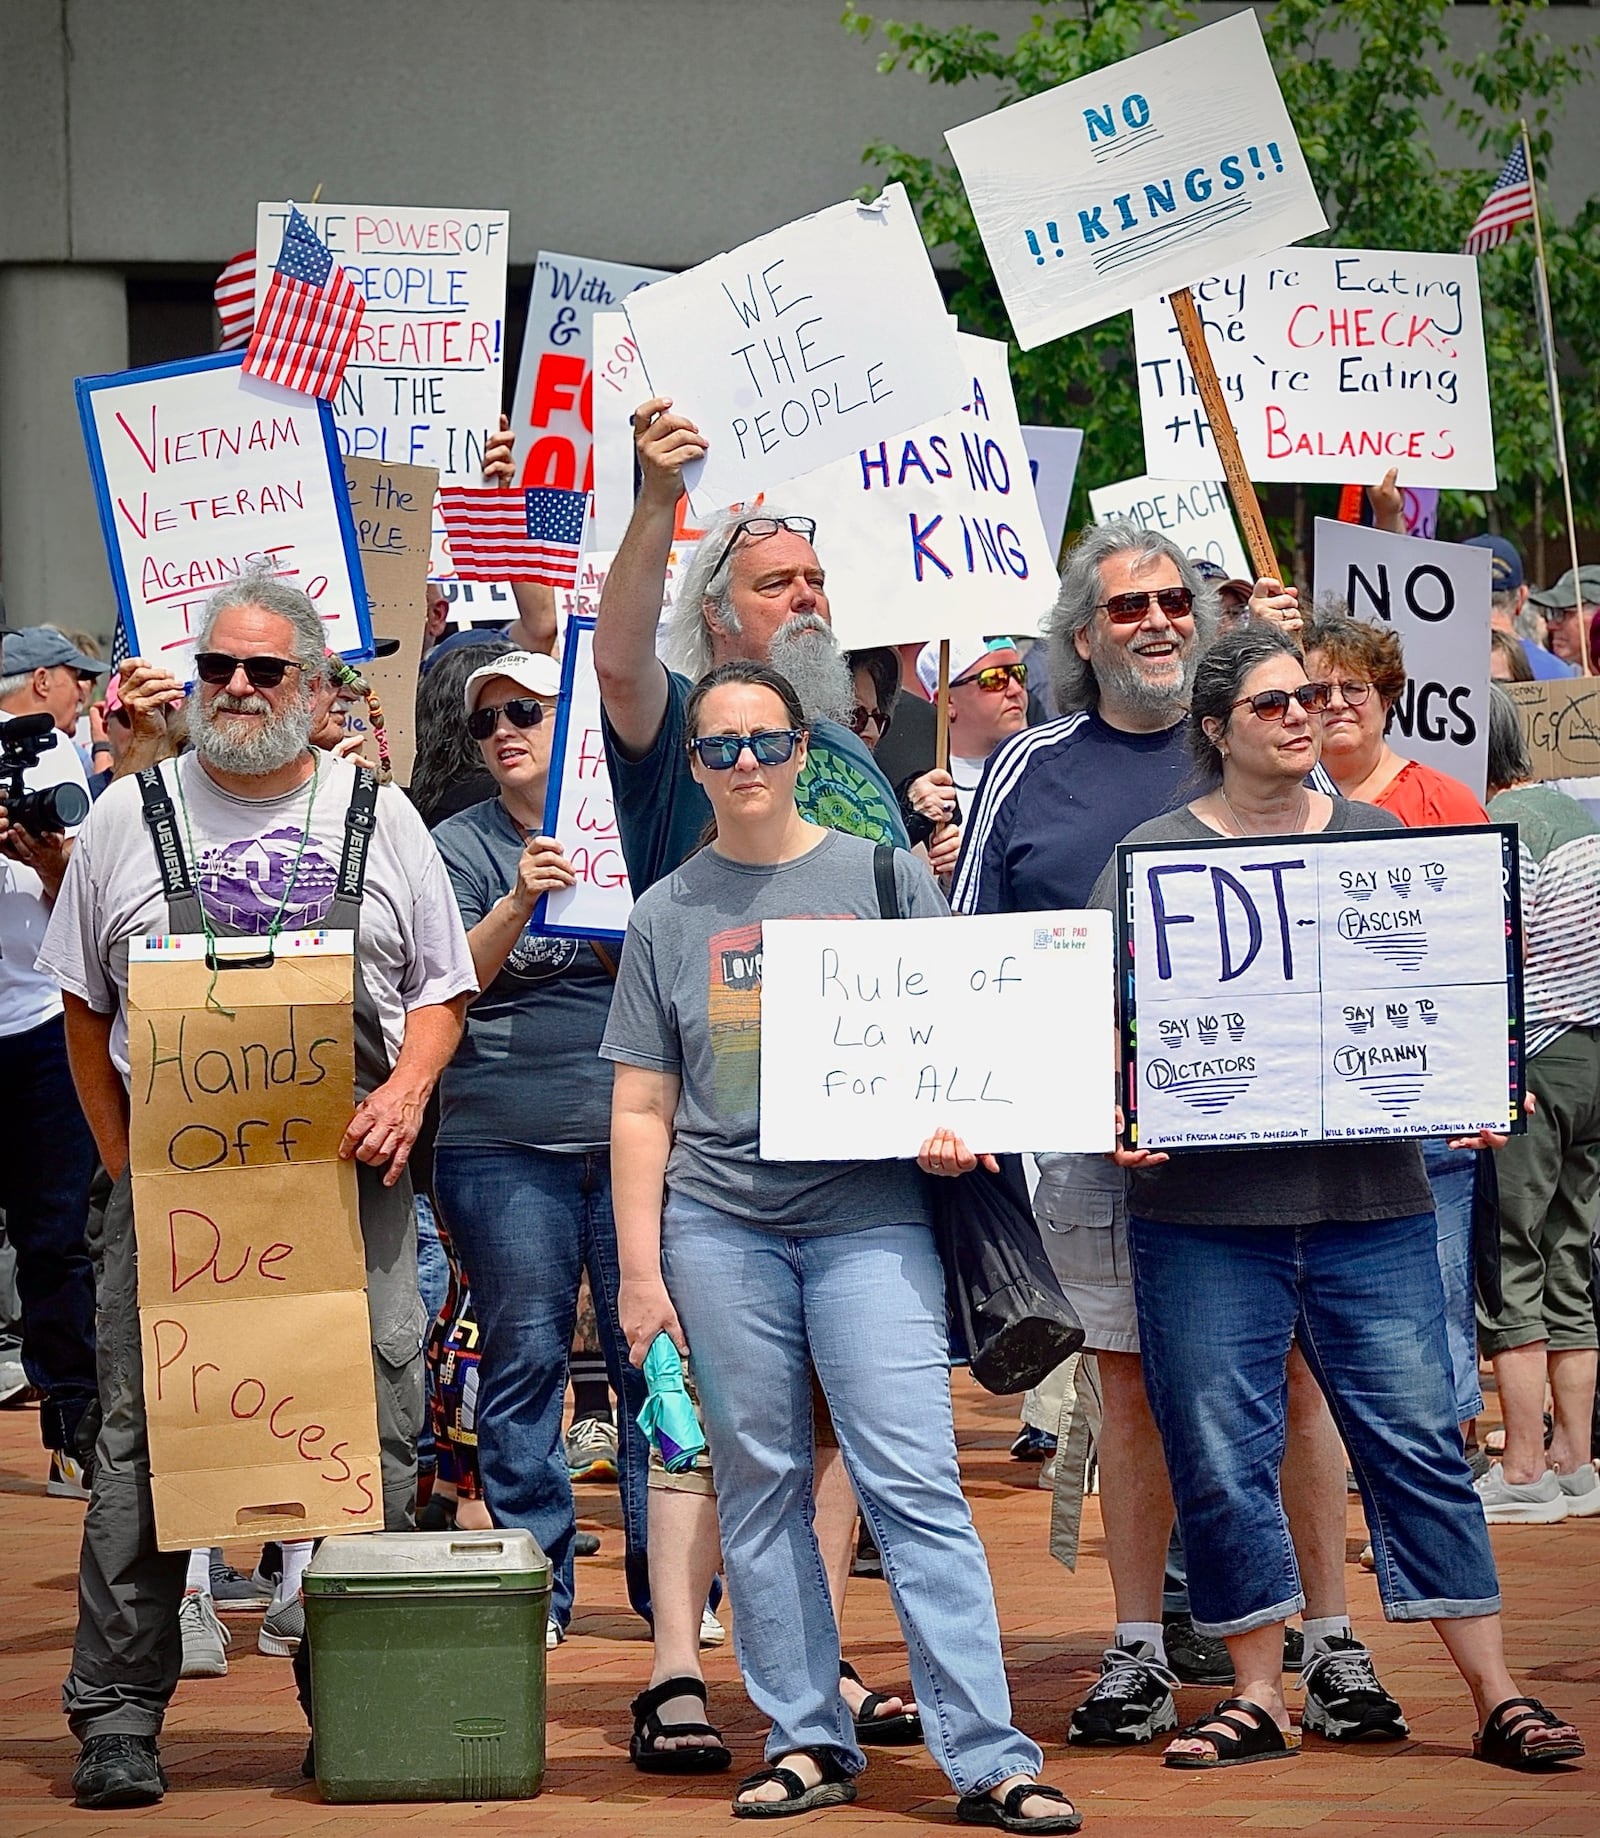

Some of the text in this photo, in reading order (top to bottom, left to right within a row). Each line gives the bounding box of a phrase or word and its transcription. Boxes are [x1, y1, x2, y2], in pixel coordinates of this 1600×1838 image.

[1082, 94, 1151, 142] NO
[356, 216, 462, 252] POWER
[465, 222, 504, 256] OF
[721, 260, 813, 328] WE
[1335, 258, 1463, 335] Eating
[550, 306, 581, 346] &
[731, 317, 845, 398] THE
[1339, 356, 1459, 404] Eating
[384, 377, 446, 416] THE
[732, 361, 894, 460] PEOPLE
[115, 405, 301, 474] VIETNAM
[1265, 405, 1456, 459] BALANCES
[859, 432, 1010, 495] HAS NO
[117, 480, 304, 539] VETERAN
[370, 474, 419, 512] the
[908, 512, 1029, 582] KING
[1347, 564, 1455, 623] NO
[1339, 862, 1445, 889] SAY NO TO
[1053, 927, 1088, 937] NOT PAID
[1062, 938, 1070, 949] be
[1071, 939, 1086, 949] here
[1340, 909, 1423, 937] FASCISM
[821, 948, 1022, 1001] Rule of
[1158, 1012, 1244, 1038] SAY NO TO
[1342, 999, 1434, 1028] SAY NO TO
[145, 1006, 339, 1105] Hands
[1151, 1056, 1257, 1088] DICTATORS
[1337, 1044, 1428, 1076] TYRANNY
[915, 1064, 1013, 1104] ALL
[1158, 1134, 1183, 1143] WHEN
[1219, 1132, 1247, 1141] COMES
[1250, 1131, 1261, 1139] TO
[1263, 1129, 1299, 1139] AMERICA
[1325, 1128, 1343, 1137] WILL
[1346, 1128, 1356, 1136] BE
[1393, 1126, 1401, 1134] IN
[1403, 1126, 1409, 1134] A
[1468, 1122, 1474, 1130] A
[1476, 1121, 1497, 1130] CROSS
[169, 1209, 294, 1293] Due
[152, 1319, 374, 1515] Process
